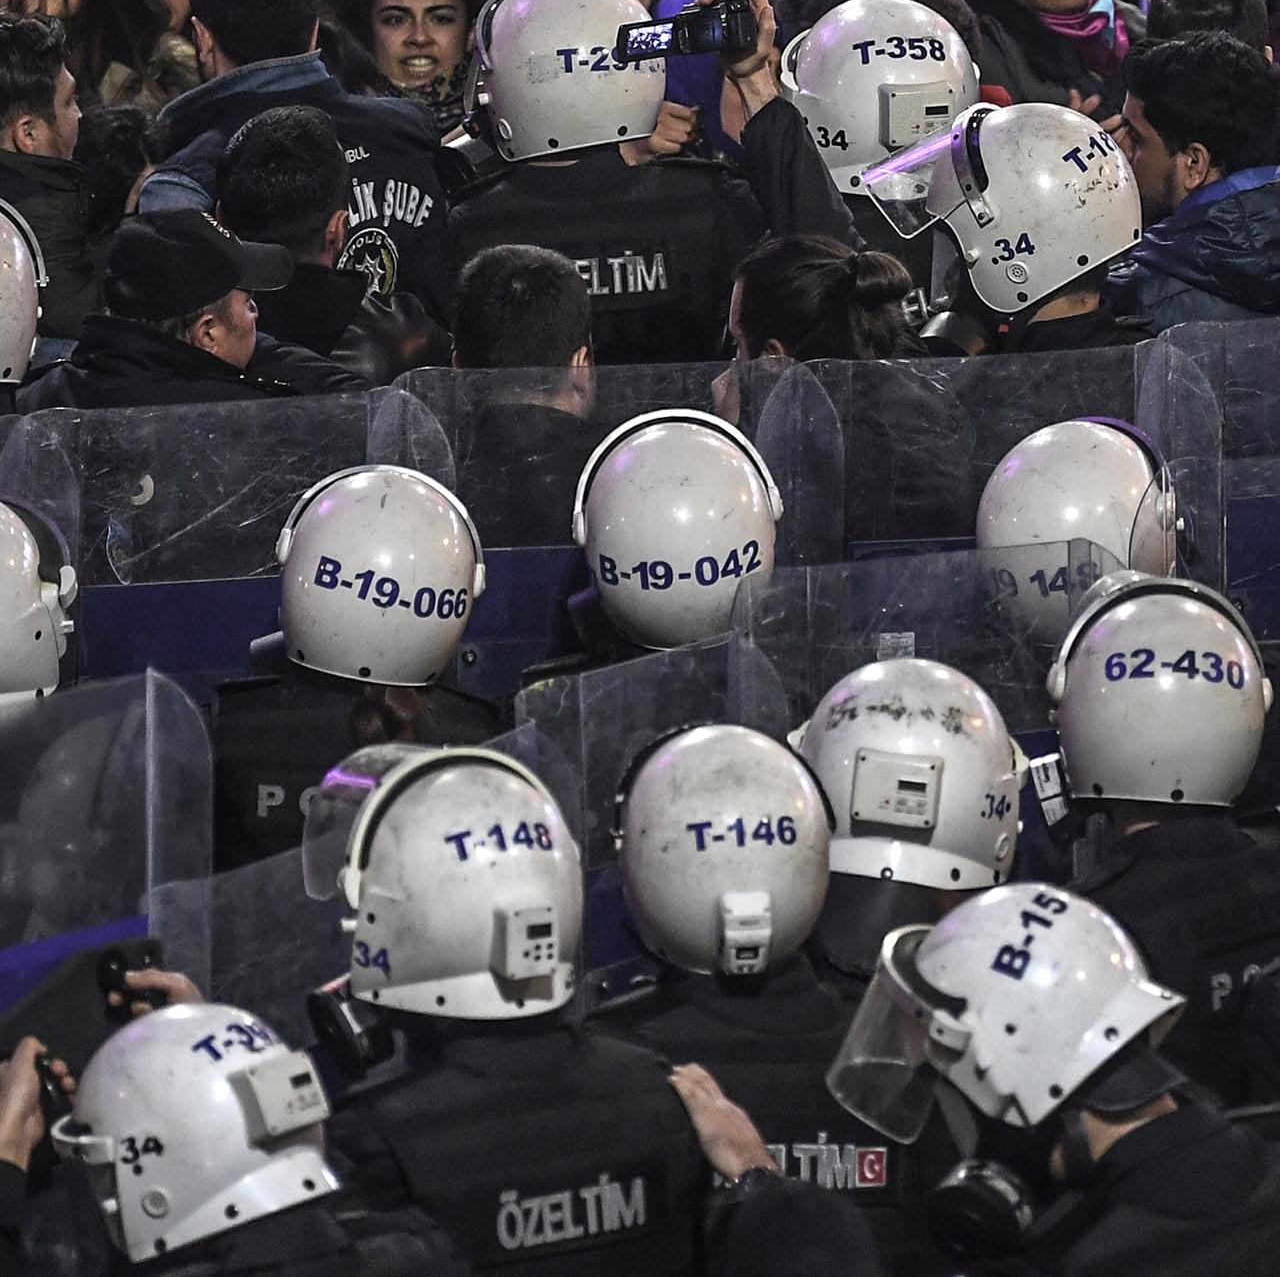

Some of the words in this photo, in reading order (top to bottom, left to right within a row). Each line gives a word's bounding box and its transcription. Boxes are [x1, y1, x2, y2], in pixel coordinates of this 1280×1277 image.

[852, 36, 946, 65] T-358
[816, 126, 849, 151] 34
[382, 179, 434, 228] ŞUBE
[598, 538, 763, 591] B-19-042
[314, 554, 468, 620] B-19-066
[1103, 647, 1245, 690] 62-430
[444, 821, 554, 862] T-148
[685, 815, 797, 854] T-146
[353, 941, 391, 972] 34
[119, 1135, 165, 1165] 34
